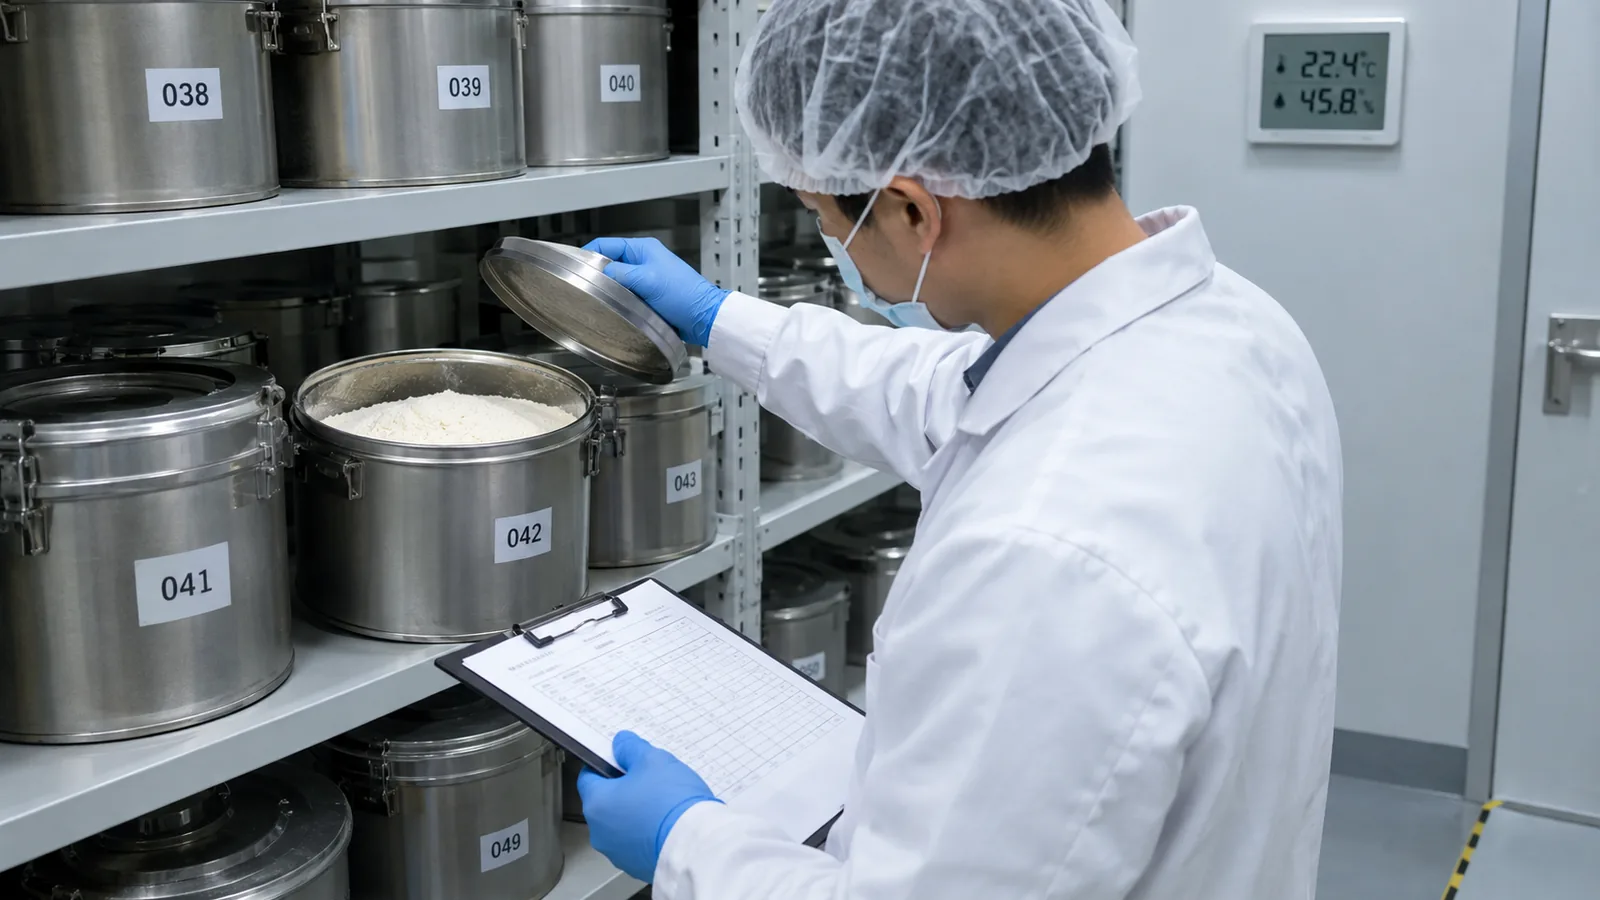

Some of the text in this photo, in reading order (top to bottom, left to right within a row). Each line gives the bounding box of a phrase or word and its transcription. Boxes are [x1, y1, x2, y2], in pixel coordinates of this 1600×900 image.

[162, 82, 209, 107] 038
[449, 76, 482, 98] 039
[609, 74, 635, 93] 040
[674, 471, 697, 492] 043
[507, 522, 542, 548] 042
[161, 568, 213, 602] 041
[491, 832, 521, 859] 049
